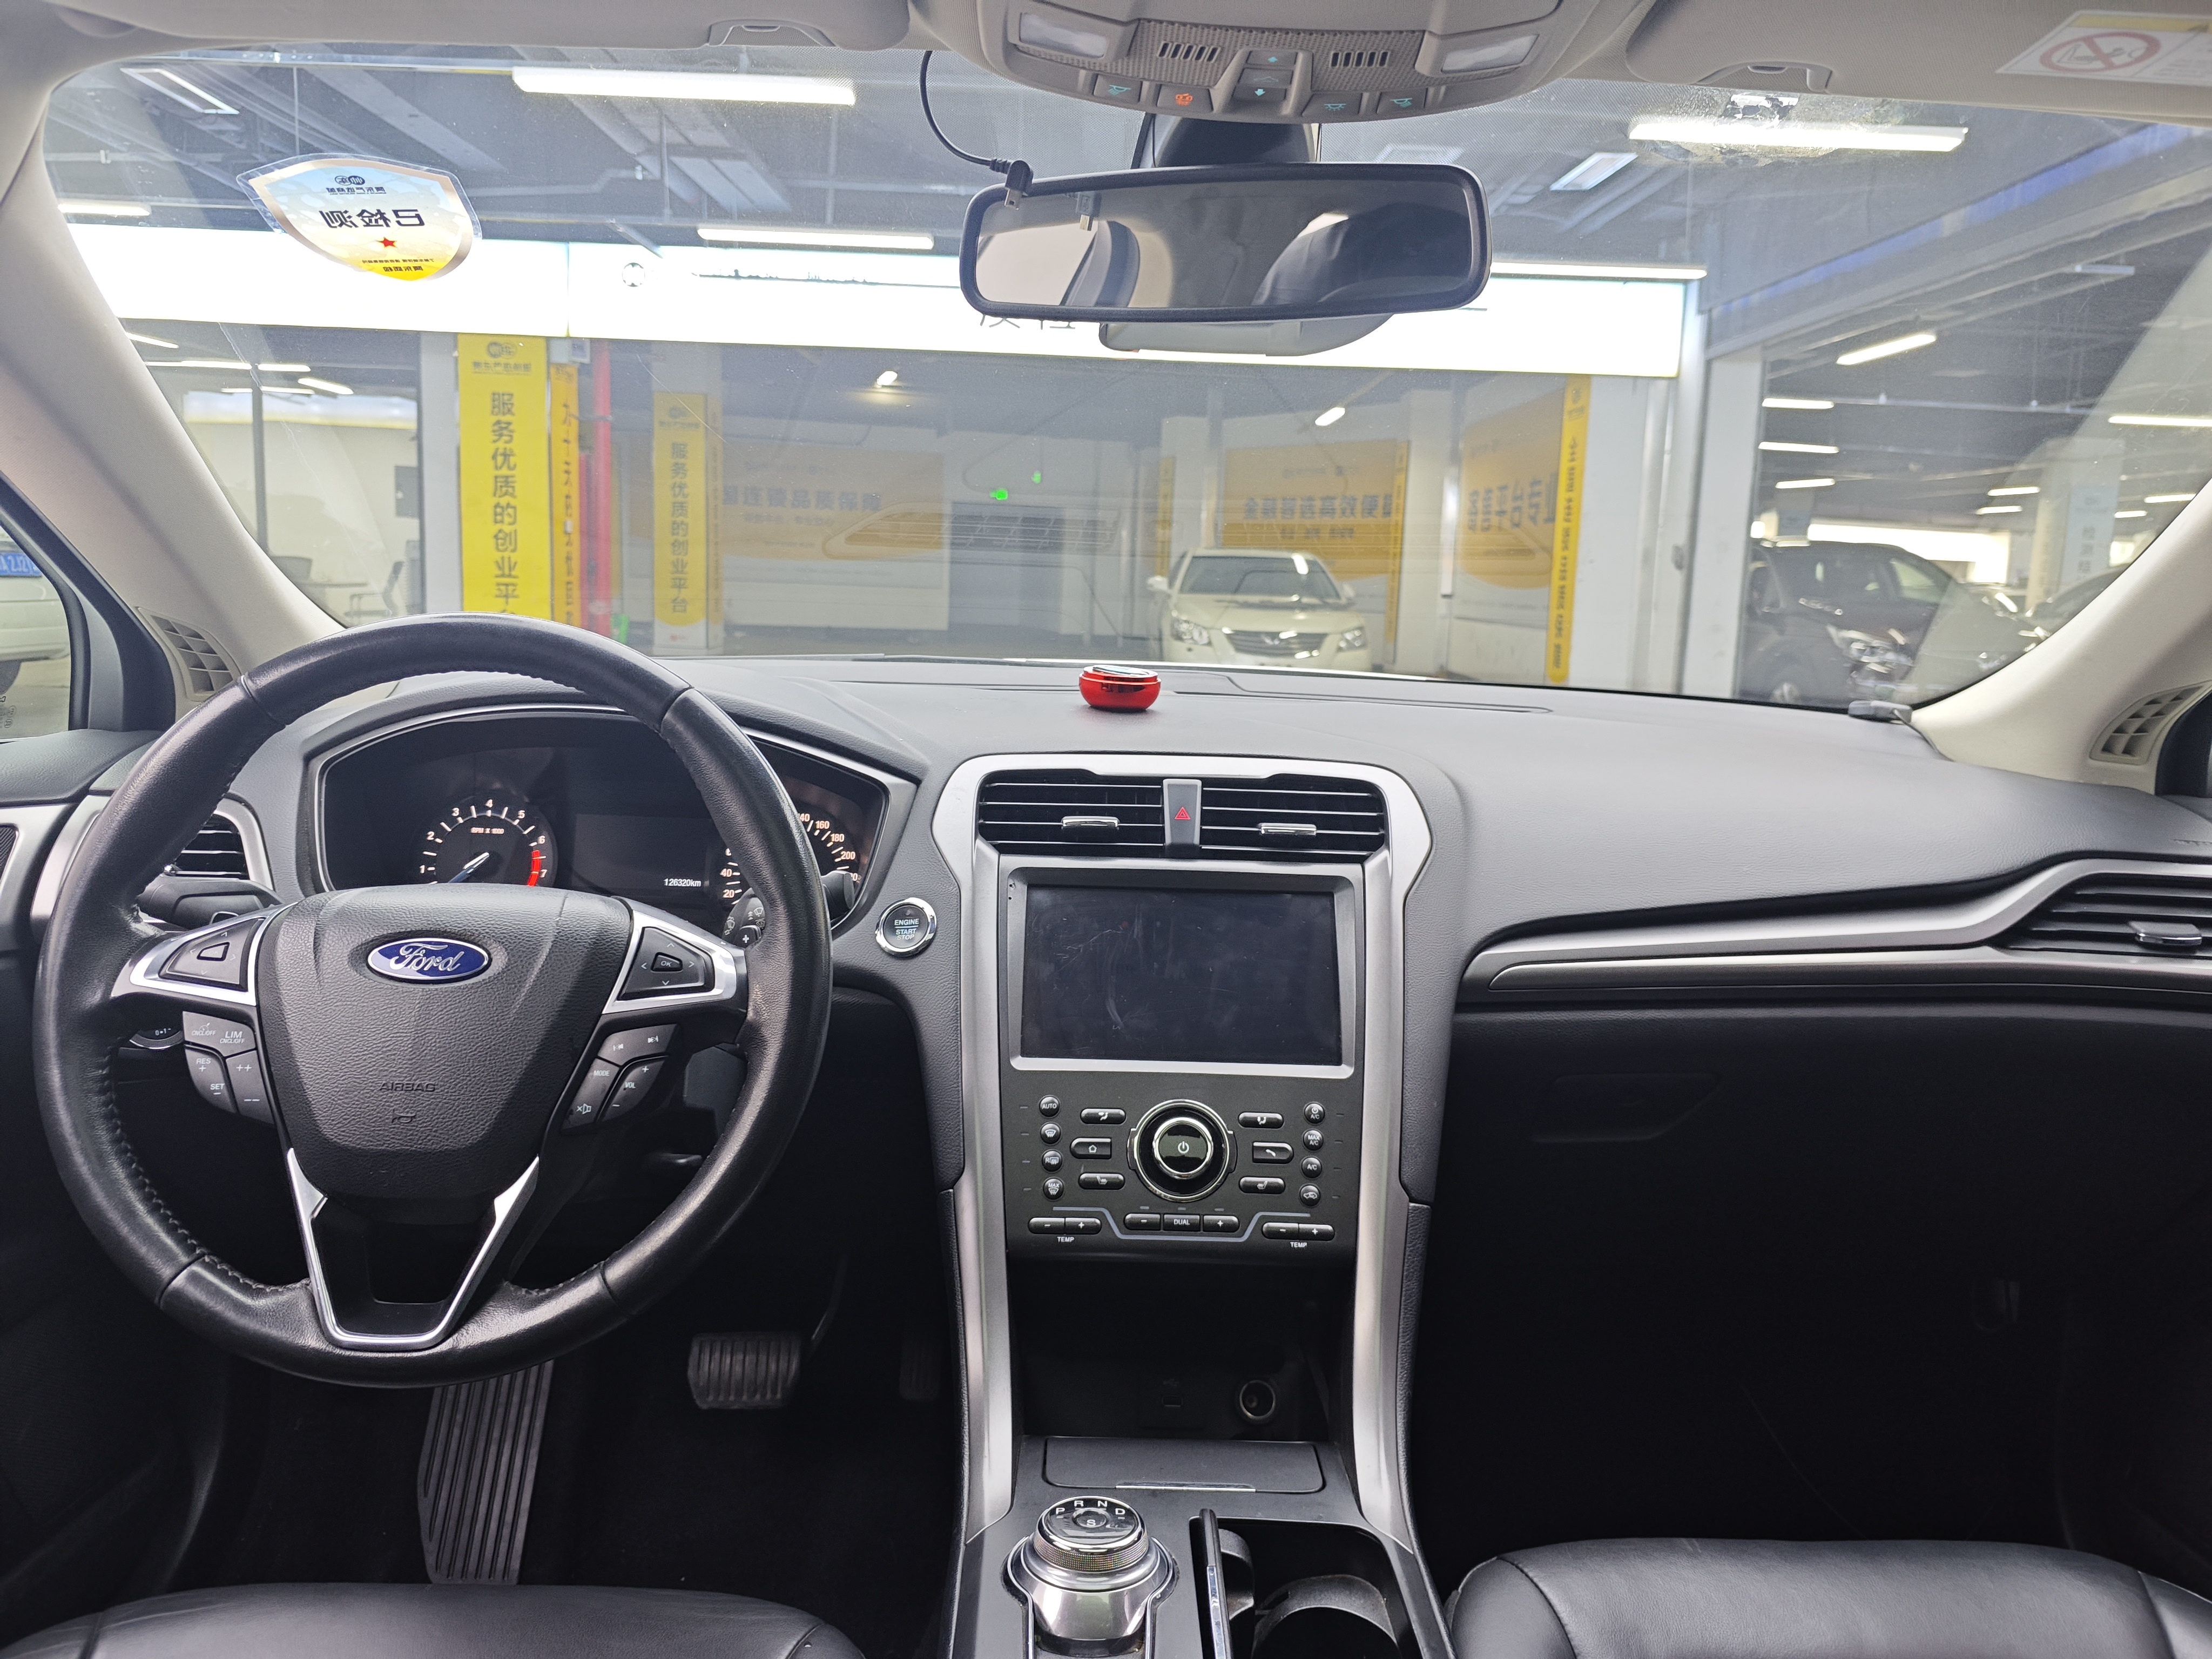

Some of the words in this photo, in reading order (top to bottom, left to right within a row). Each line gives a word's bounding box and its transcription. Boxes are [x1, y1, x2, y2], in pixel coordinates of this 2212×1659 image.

[490, 392, 520, 614] 服务优质的创业平
[671, 443, 689, 613] 服务优质的创业平台
[485, 799, 493, 808] 4
[452, 808, 460, 817] 3
[518, 810, 525, 819] 5
[815, 820, 830, 830] 160
[427, 831, 435, 840] 2
[537, 835, 545, 844] 6
[831, 833, 845, 842] 180
[840, 851, 856, 860] 200
[420, 865, 425, 874] 1
[539, 869, 548, 878] 7
[720, 868, 732, 877] 40
[664, 878, 702, 887] 126320km
[723, 889, 735, 898] 20
[389, 943, 464, 971] Ford
[379, 1081, 436, 1092] AIRBAG
